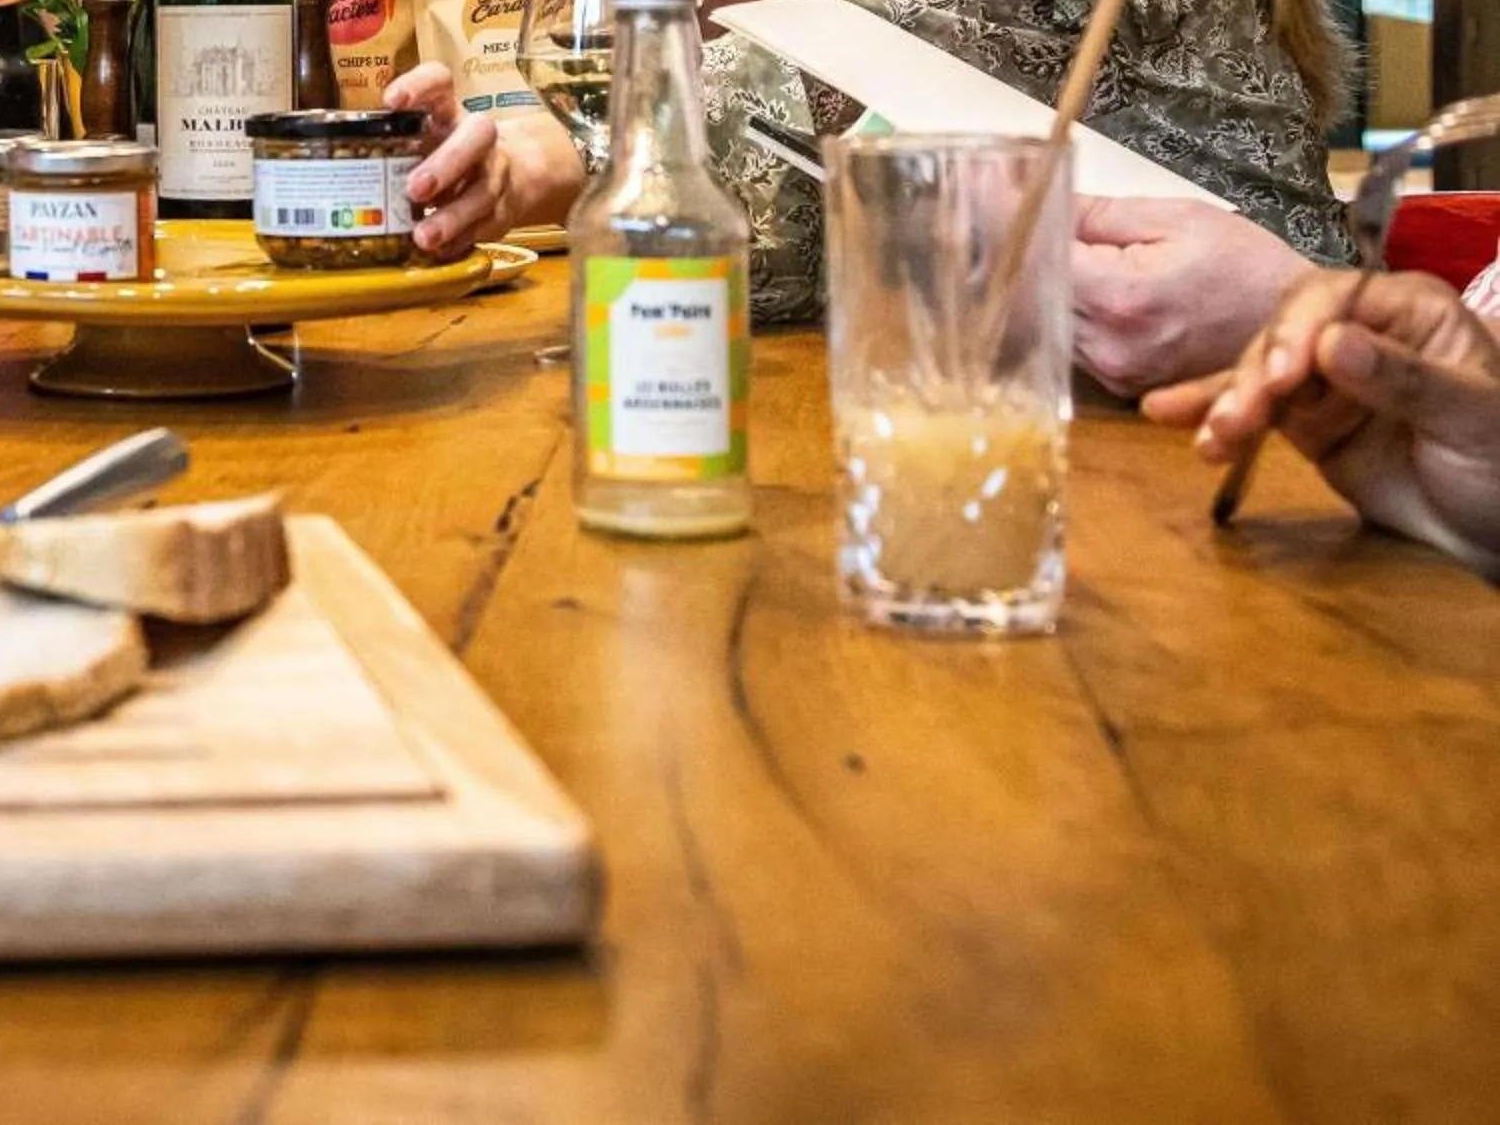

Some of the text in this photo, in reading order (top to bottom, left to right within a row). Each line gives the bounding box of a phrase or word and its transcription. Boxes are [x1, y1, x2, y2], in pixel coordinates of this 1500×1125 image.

[337, 56, 373, 68] CHIPS
[180, 118, 244, 132] MALB
[30, 201, 99, 219] PAYZAN
